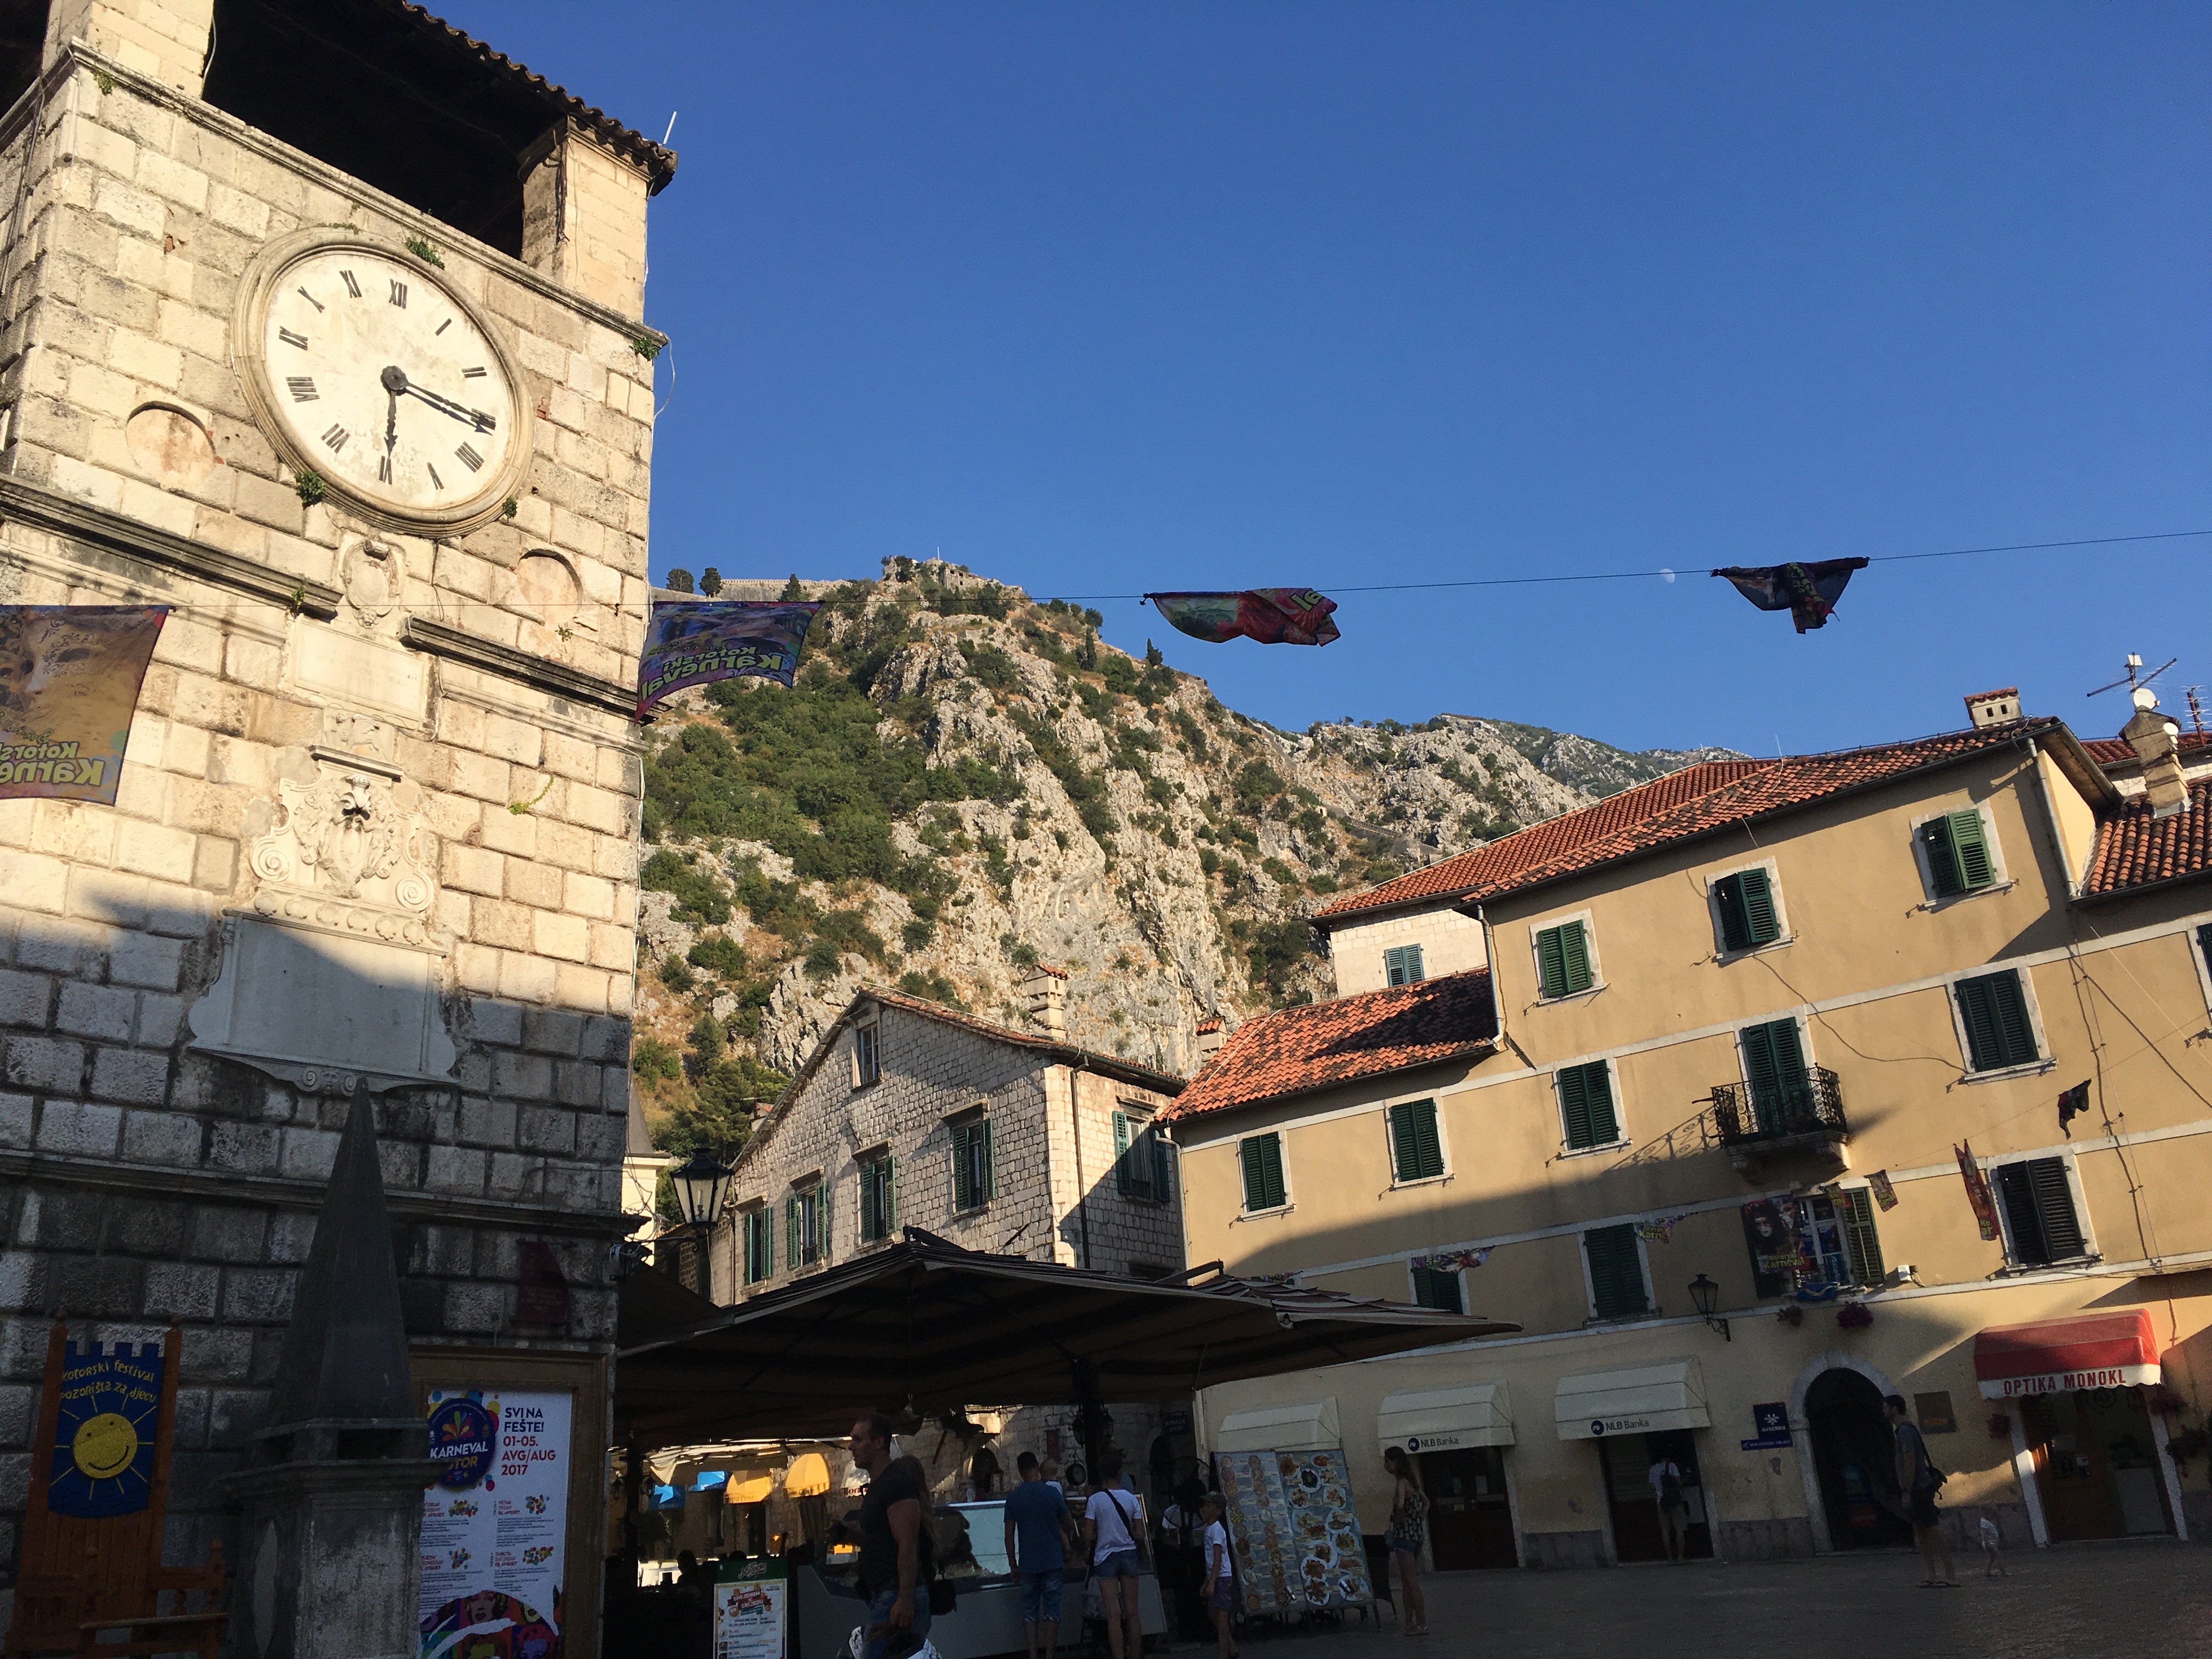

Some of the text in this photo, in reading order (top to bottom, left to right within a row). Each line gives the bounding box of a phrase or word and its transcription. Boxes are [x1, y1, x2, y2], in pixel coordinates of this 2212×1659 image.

[297, 285, 325, 313] X
[388, 278, 408, 309] XII
[461, 366, 487, 379] II
[2004, 1369, 2126, 1395] OPTIKA MONOKL
[505, 1408, 543, 1419] SVI NA
[504, 1419, 544, 1433] FEŠTE!
[1605, 1419, 1649, 1431] NLB Banka
[503, 1436, 539, 1447] 01-05.
[1421, 1437, 1459, 1447] NLB Banka
[430, 1441, 488, 1459] KARNEVAL
[501, 1449, 556, 1464] AVG/AUG
[501, 1465, 528, 1476] 2017
